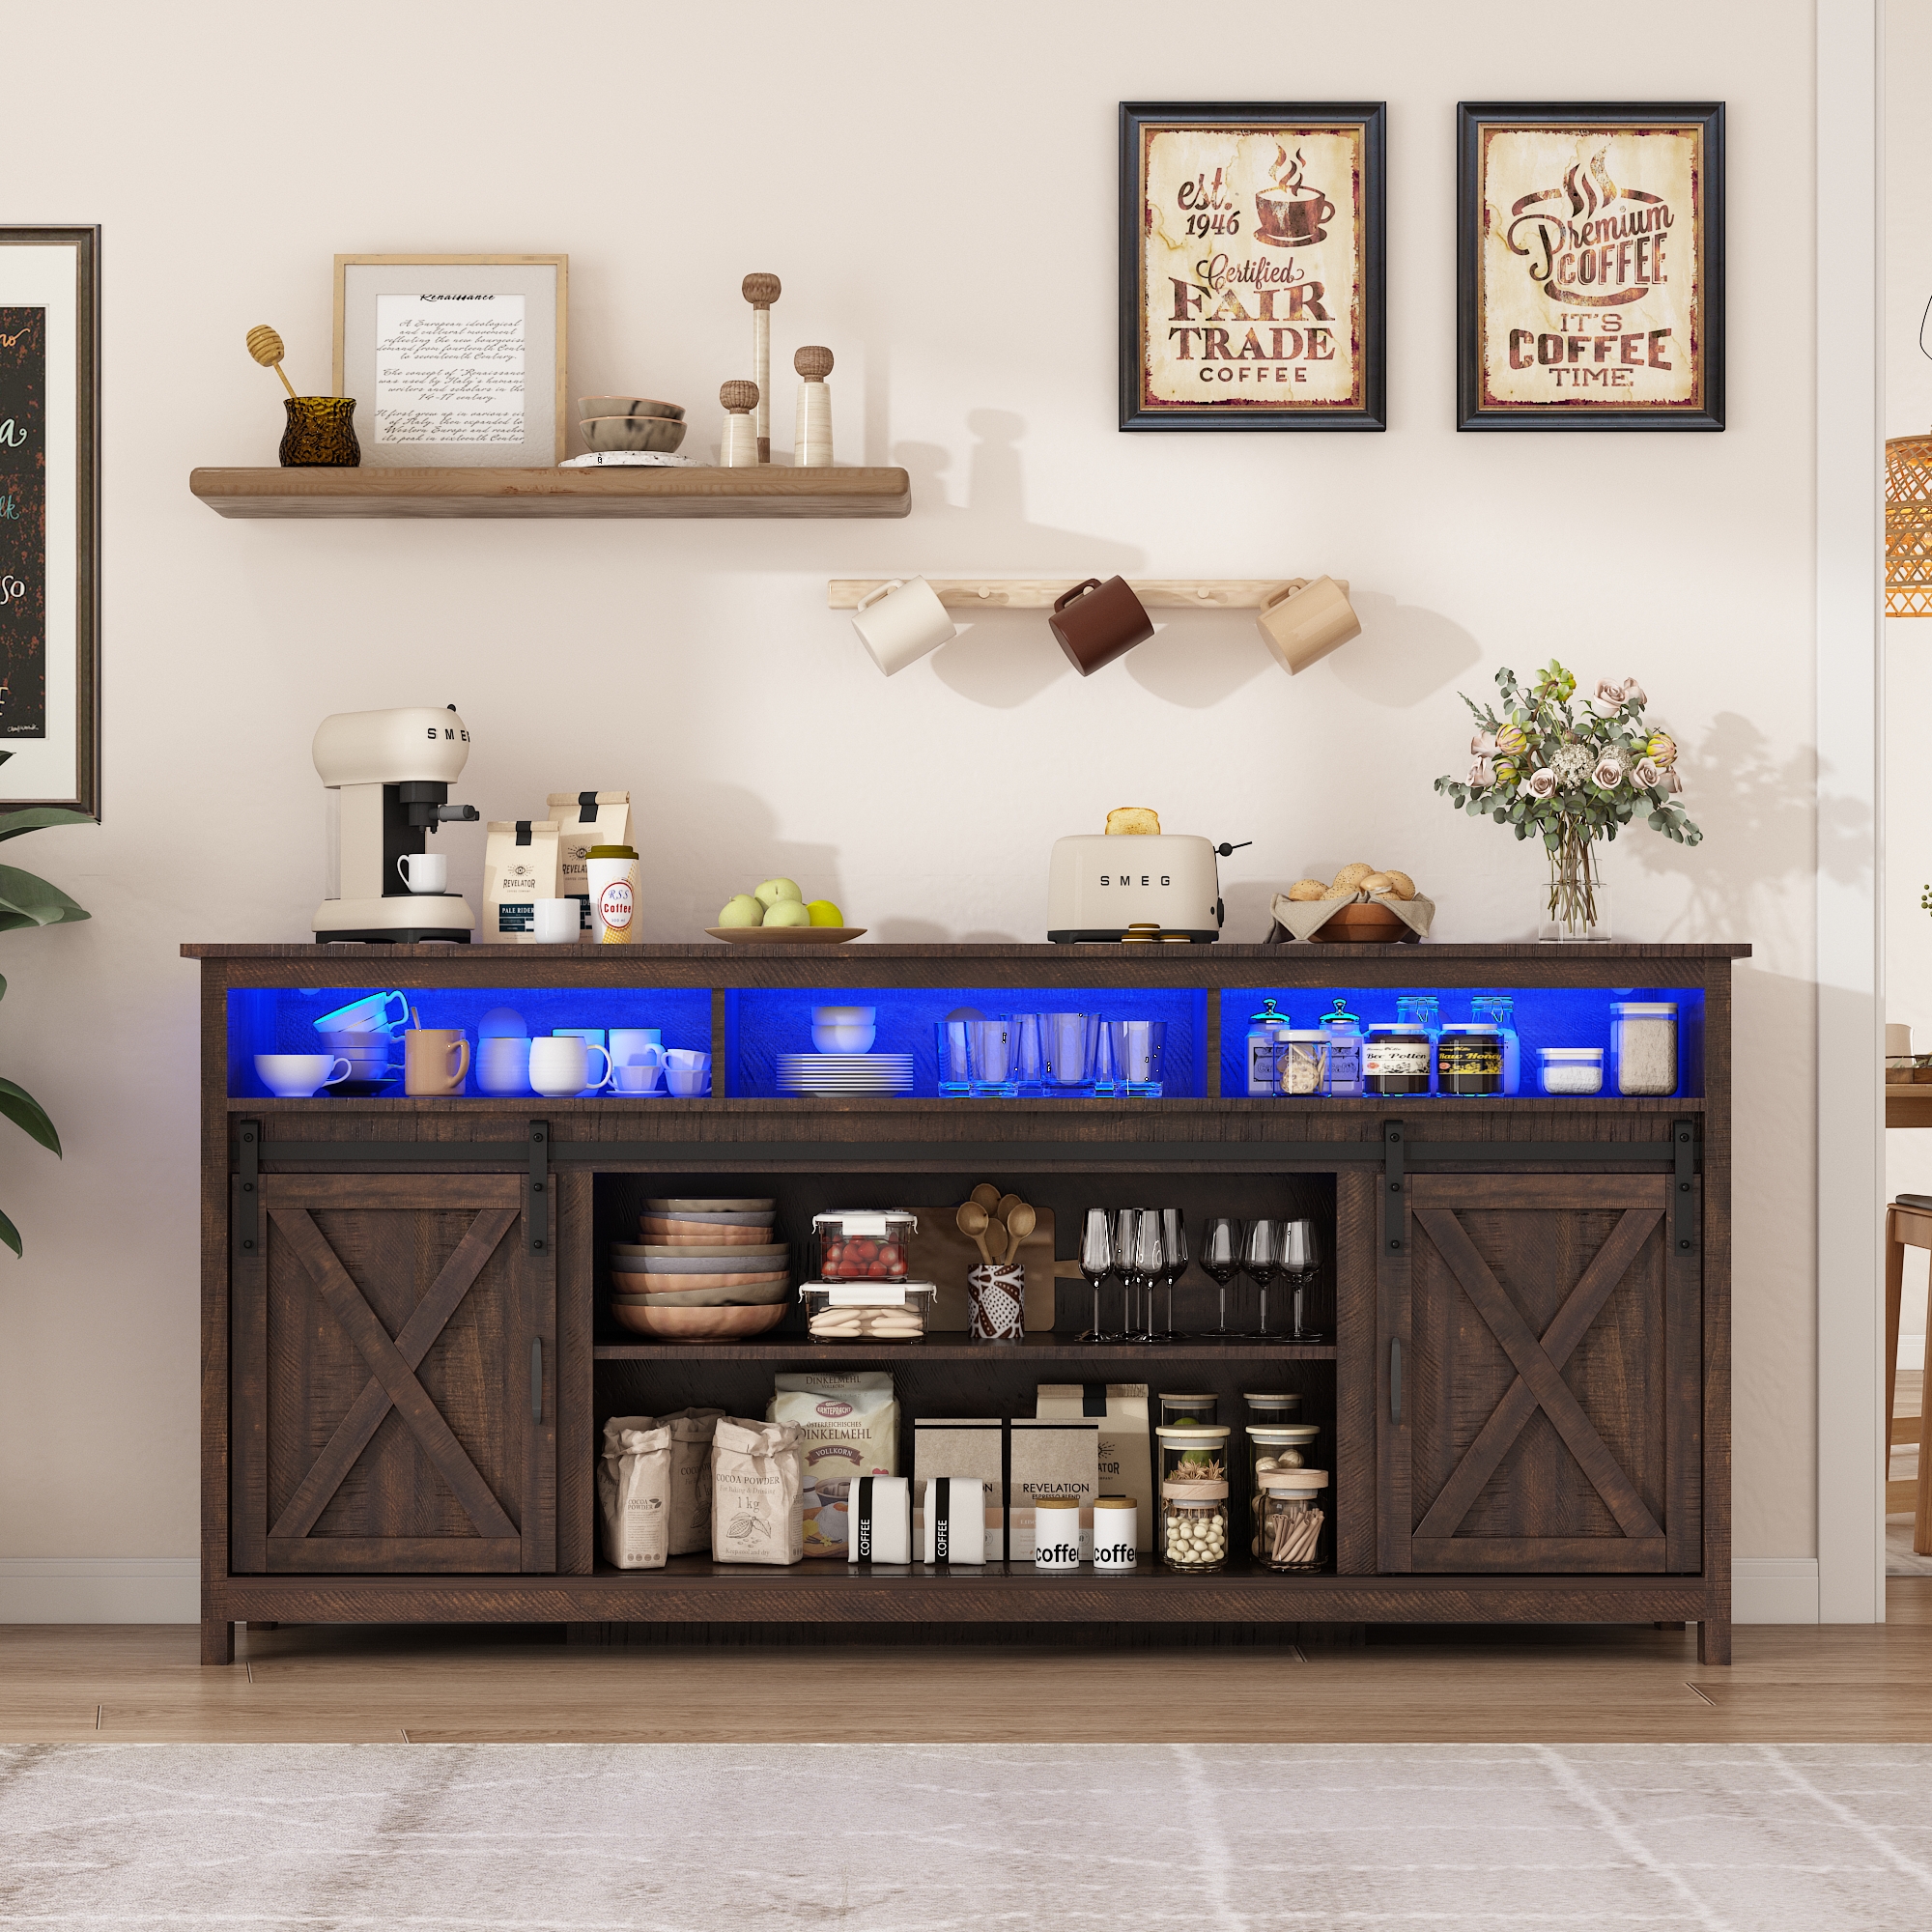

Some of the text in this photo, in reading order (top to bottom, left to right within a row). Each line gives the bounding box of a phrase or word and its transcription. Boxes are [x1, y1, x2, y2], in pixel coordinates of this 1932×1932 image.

[1178, 167, 1233, 211] est.
[1185, 210, 1241, 239] 1946
[1507, 204, 1675, 281] Premium
[1556, 233, 1668, 286] COFFEE
[1196, 253, 1305, 293] Certified
[419, 294, 497, 302] Renaissance
[1168, 276, 1336, 322] FAIR
[1560, 313, 1623, 332] IT'S
[1168, 327, 1336, 361] TRADE
[1509, 327, 1672, 371] COFFEE
[1200, 367, 1308, 383] COFFEE
[1548, 368, 1634, 387] TIME
[502, 878, 536, 889] REVELATOR
[1100, 875, 1171, 886] SMEG
[604, 903, 632, 914] Coffee
[806, 1375, 862, 1385] DINKELMEHL
[815, 1447, 853, 1457] VOLLKORN
[716, 1473, 742, 1484] COCOA
[744, 1476, 781, 1486] POWDER
[1023, 1483, 1090, 1493] REVELATION
[738, 1496, 760, 1513] 1 kg
[860, 1519, 870, 1556] COFFEE
[937, 1520, 948, 1556] COFFEE
[1094, 1544, 1137, 1563] coffe
